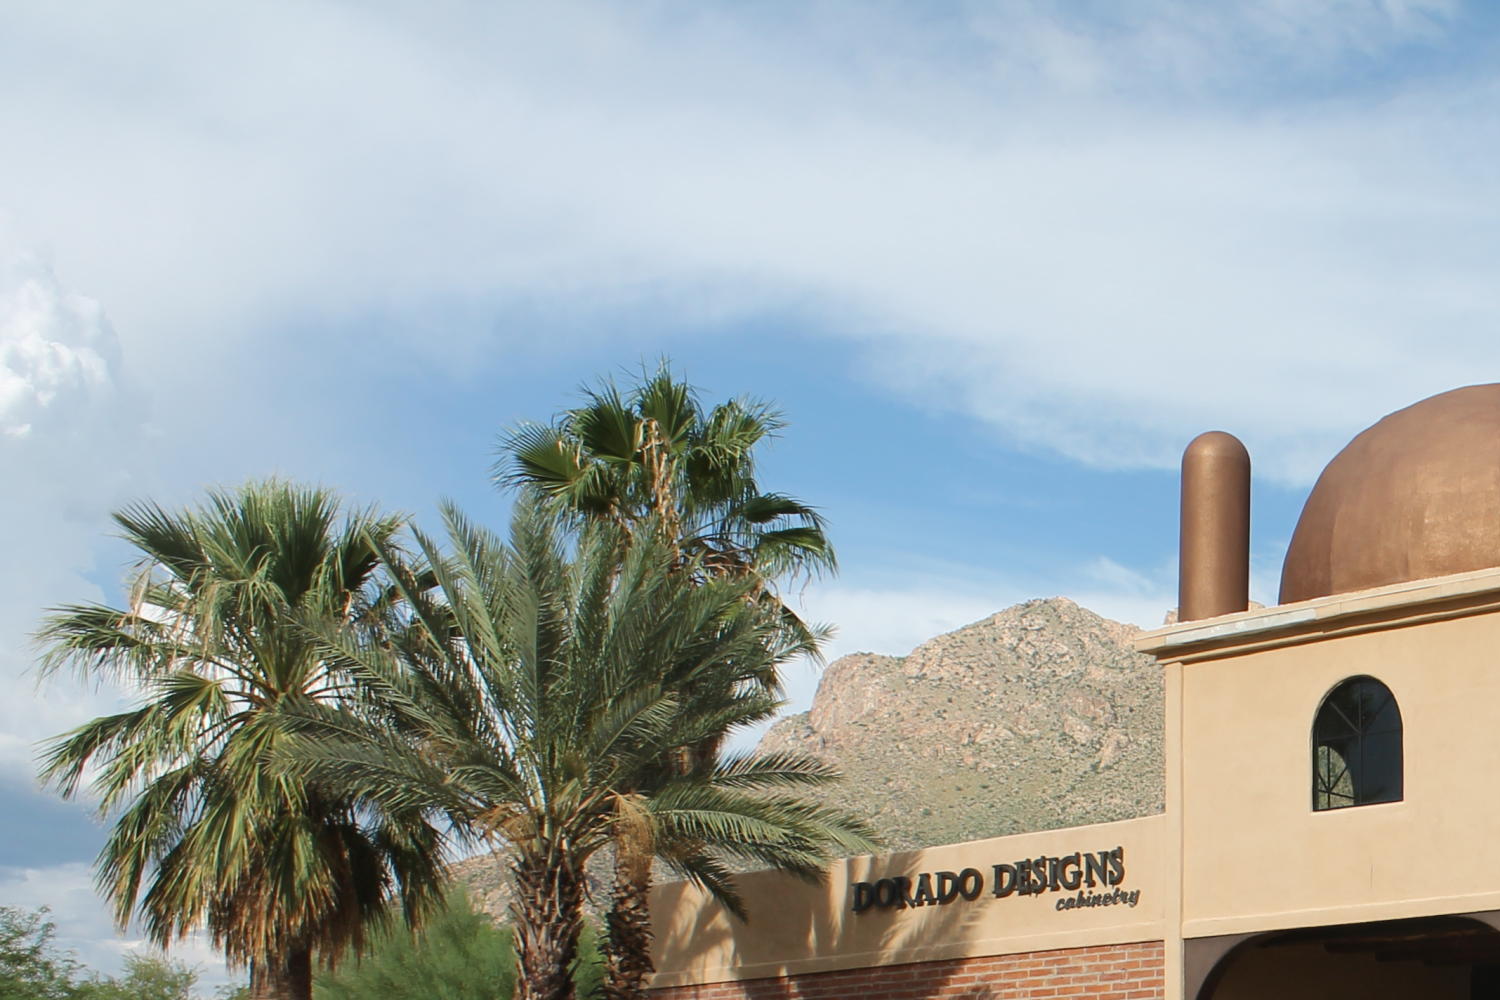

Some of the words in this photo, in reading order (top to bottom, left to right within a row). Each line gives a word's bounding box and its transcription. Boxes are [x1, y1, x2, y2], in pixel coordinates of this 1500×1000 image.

[852, 867, 983, 914] DORADO
[992, 846, 1125, 898] DESIGNS
[1055, 887, 1140, 912] cabinetry
